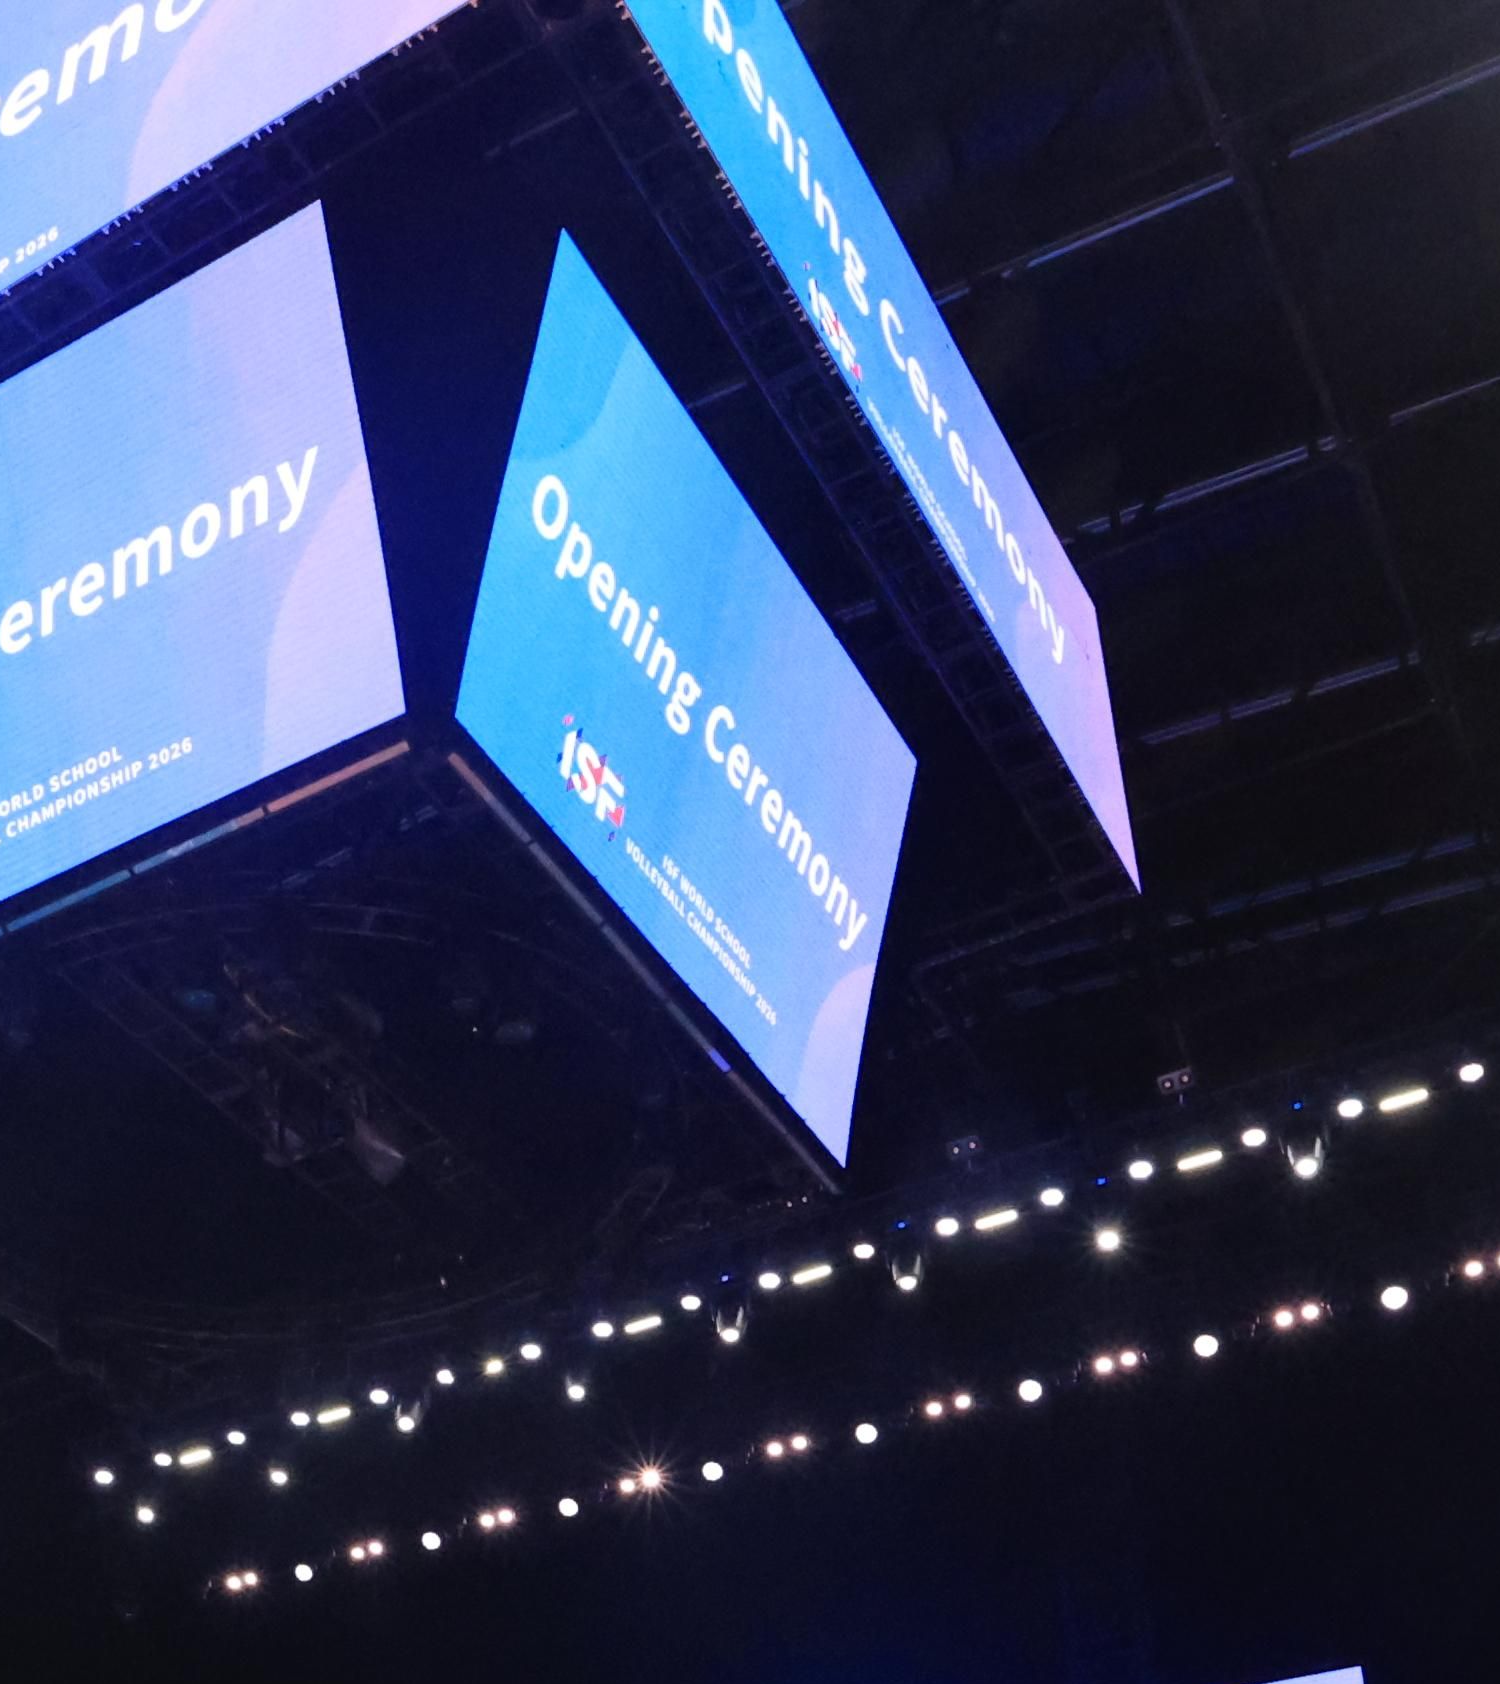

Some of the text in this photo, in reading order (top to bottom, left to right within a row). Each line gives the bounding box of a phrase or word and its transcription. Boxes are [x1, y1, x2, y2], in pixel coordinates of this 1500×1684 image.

[16, 227, 58, 263] 2026
[879, 298, 1066, 664] Ceremony
[531, 475, 867, 951] Opening Ceremony
[6, 761, 142, 839] CHAMPIONSHIP
[149, 737, 193, 770] 2026
[49, 746, 122, 791] SCHOOL
[560, 731, 624, 821] ISF
[625, 837, 686, 917] VOLLEYBALL
[686, 911, 757, 997] CHAMPIONSHIP
[661, 855, 752, 969] ISF WORLD SCHOOL
